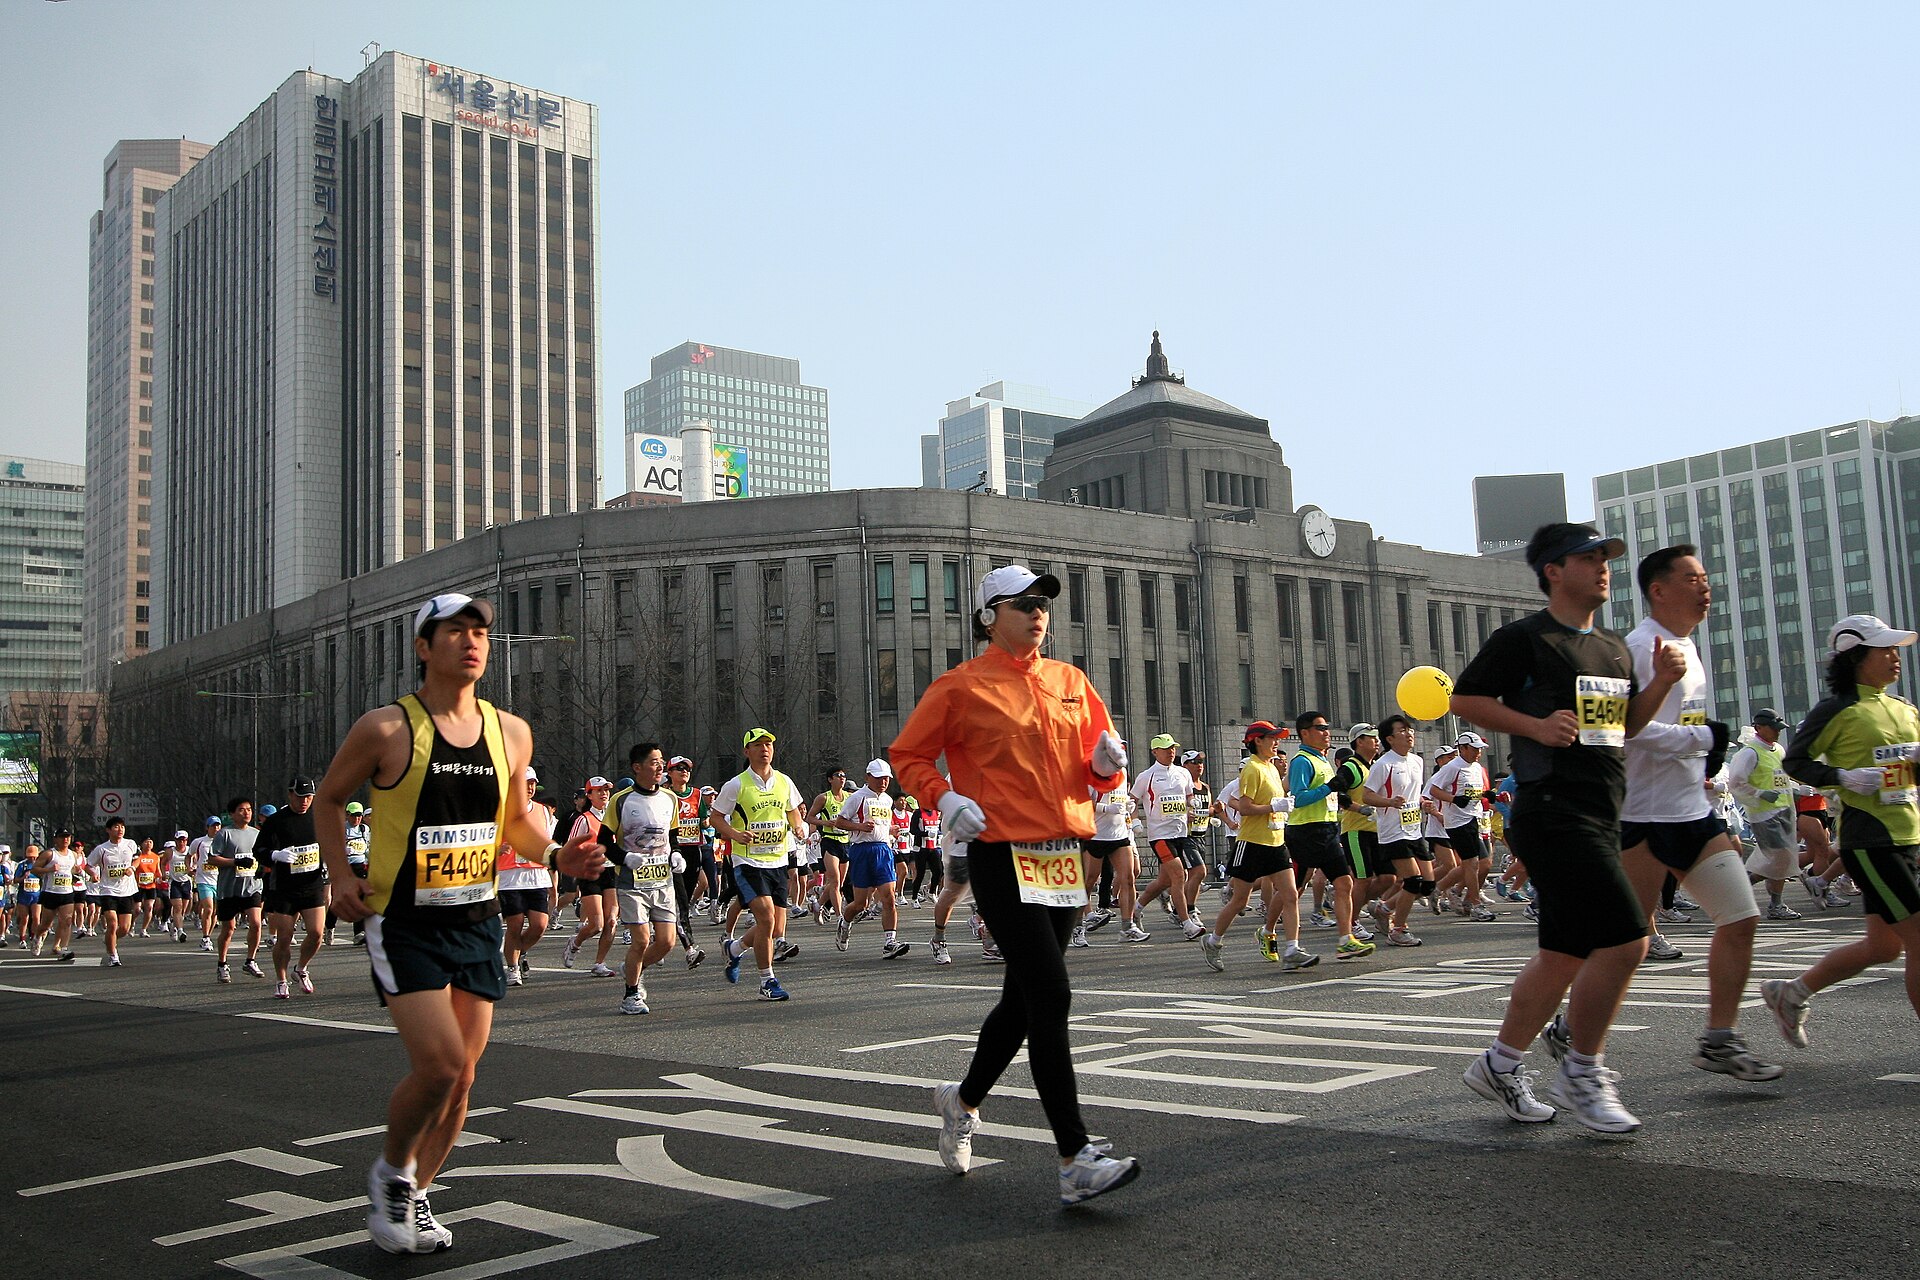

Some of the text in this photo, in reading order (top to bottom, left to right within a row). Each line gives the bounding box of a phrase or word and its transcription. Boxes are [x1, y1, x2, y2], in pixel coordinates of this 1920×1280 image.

[437, 72, 563, 129] 서울신문
[457, 108, 540, 139] seoul.co.kr
[313, 94, 338, 304] 한국프레스센터
[691, 353, 705, 365] SK
[643, 442, 664, 455] ACE
[643, 466, 742, 498] AC ED
[432, 762, 494, 776] 동대문달리기
[420, 827, 494, 845] SAMSUNG
[752, 831, 782, 844] E4252
[425, 849, 490, 883] F4406
[636, 864, 668, 880] E2103
[1018, 855, 1078, 886] E7133
